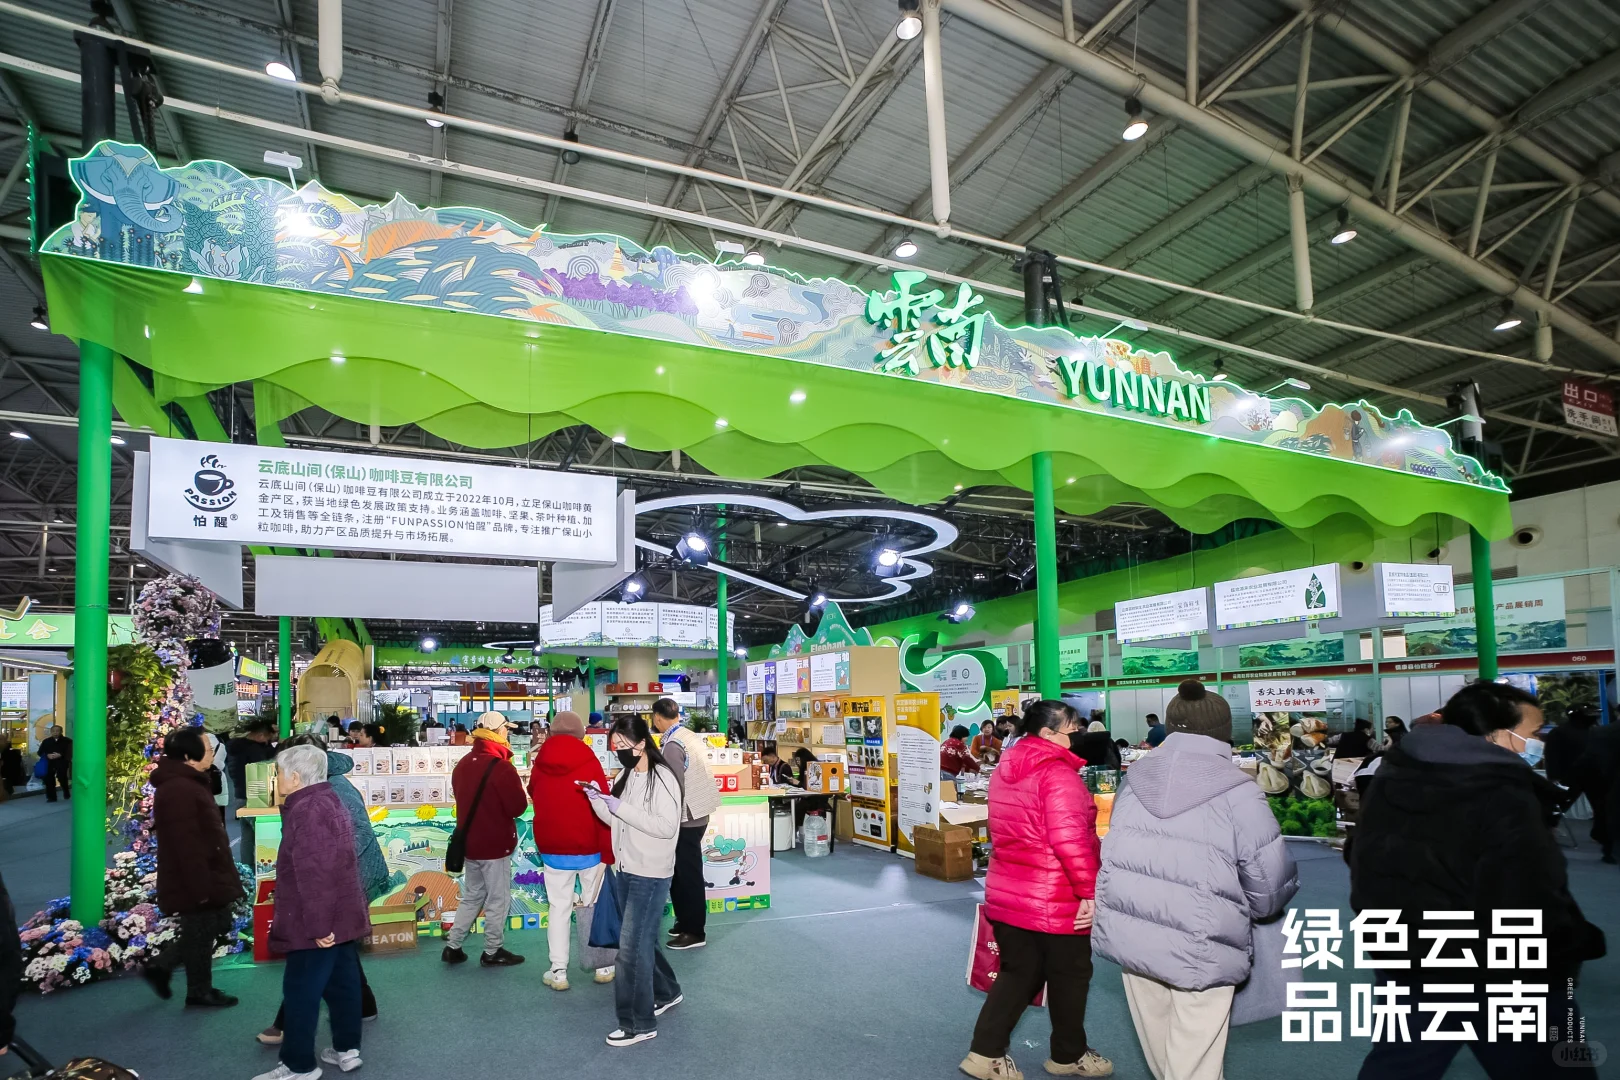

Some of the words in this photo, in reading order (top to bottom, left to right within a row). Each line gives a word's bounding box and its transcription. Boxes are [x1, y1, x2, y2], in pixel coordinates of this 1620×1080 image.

[865, 270, 985, 376] 雲南
[1056, 355, 1212, 423] YUNNAN
[1564, 383, 1597, 403] 出口
[184, 488, 237, 506] PASSION
[1255, 686, 1316, 697] 舌尖上的美味
[363, 931, 414, 945] BEATON
